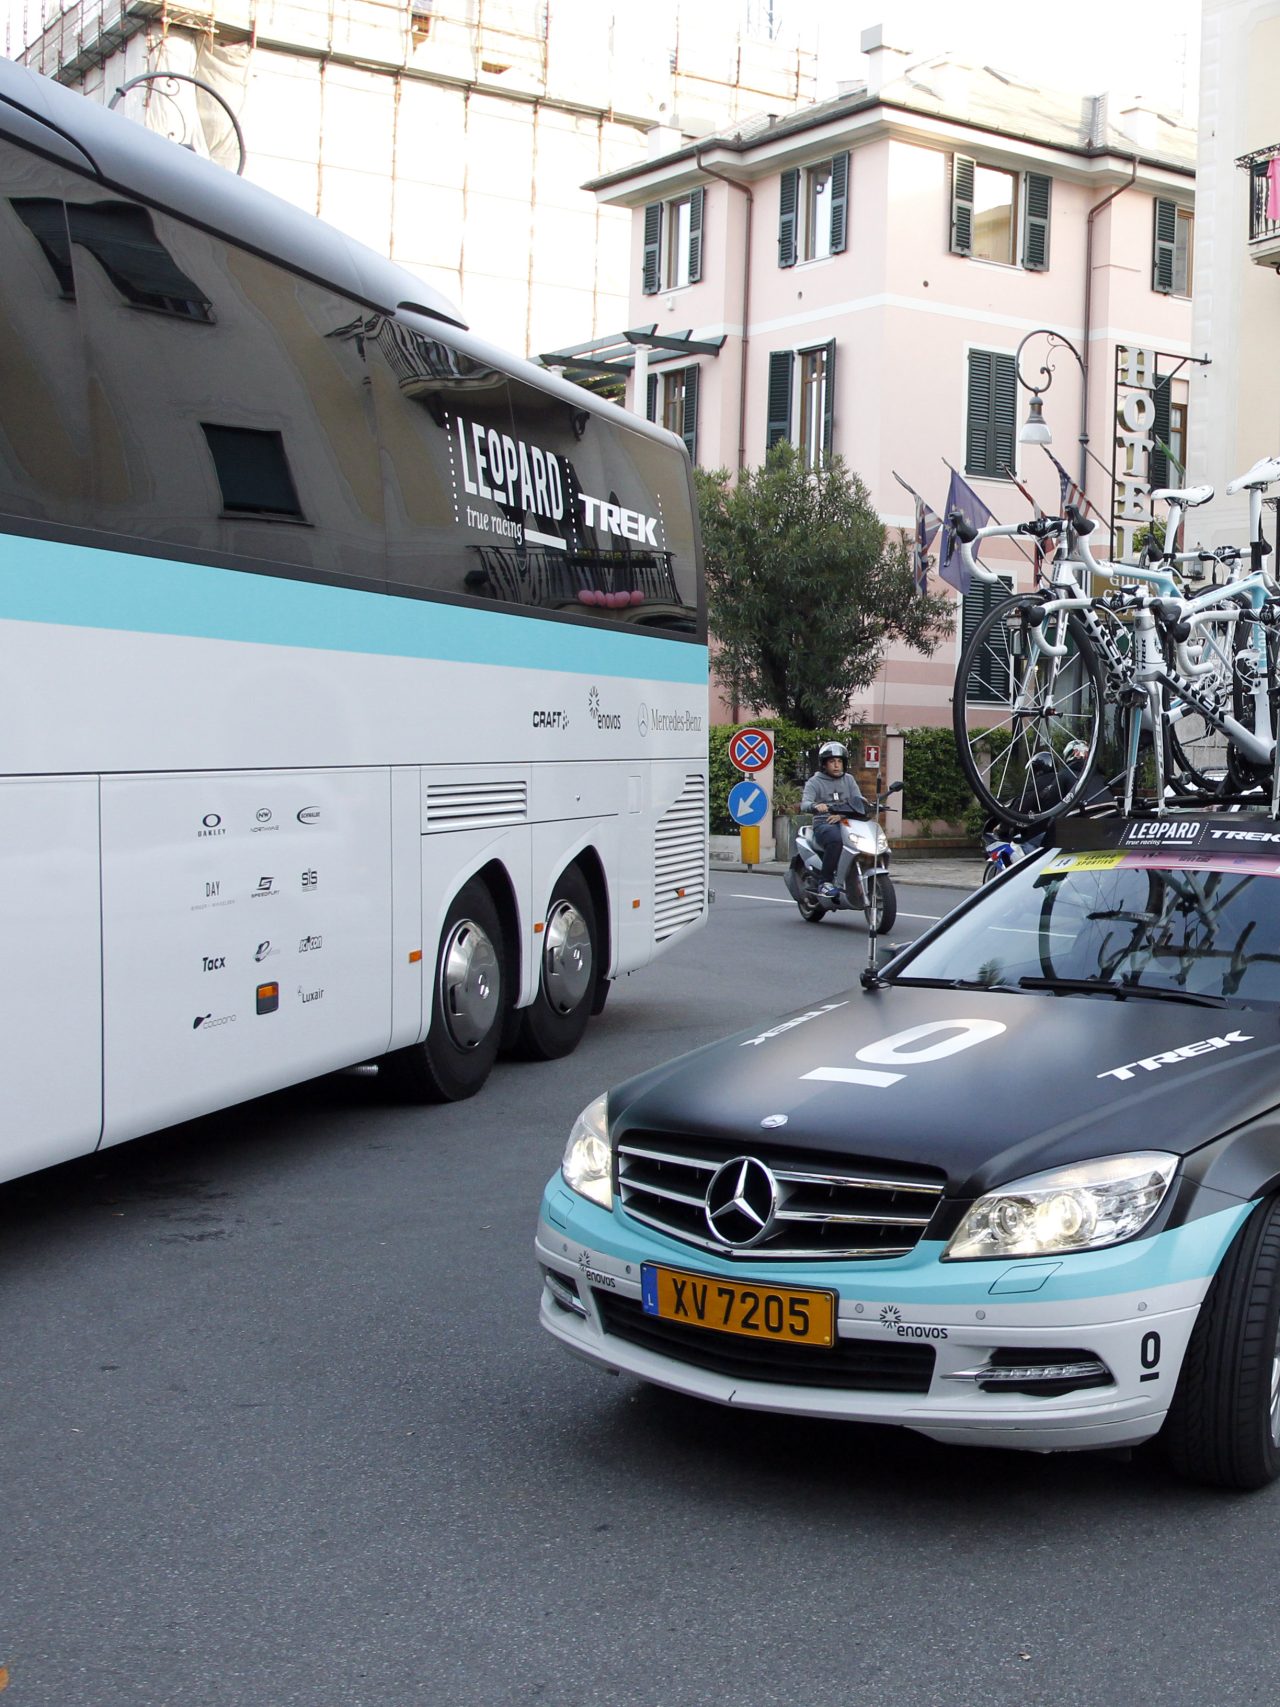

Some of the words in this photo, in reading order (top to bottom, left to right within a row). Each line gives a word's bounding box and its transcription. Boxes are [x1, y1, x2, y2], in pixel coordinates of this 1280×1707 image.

[1117, 347, 1157, 566] HOTEL
[457, 417, 564, 520] LEOPARD
[466, 506, 490, 530] true
[490, 516, 523, 545] racing
[578, 493, 658, 547] TREK
[532, 711, 562, 729] CRAFT
[597, 714, 621, 730] enovos
[651, 708, 702, 733] Mercedes-Benz
[197, 828, 227, 838] OAKLEY
[1128, 822, 1200, 840] LEOPARD
[1140, 839, 1161, 847] racing
[205, 881, 221, 897] DAY
[203, 956, 226, 972] Tacx
[302, 988, 325, 1004] Luxair
[738, 1000, 851, 1047] TREK
[1096, 1030, 1255, 1081] TREK
[586, 1270, 616, 1288] enovos
[647, 1294, 654, 1306] L
[671, 1277, 708, 1320] XV
[717, 1287, 810, 1336] 7205
[896, 1325, 948, 1339] enovos
